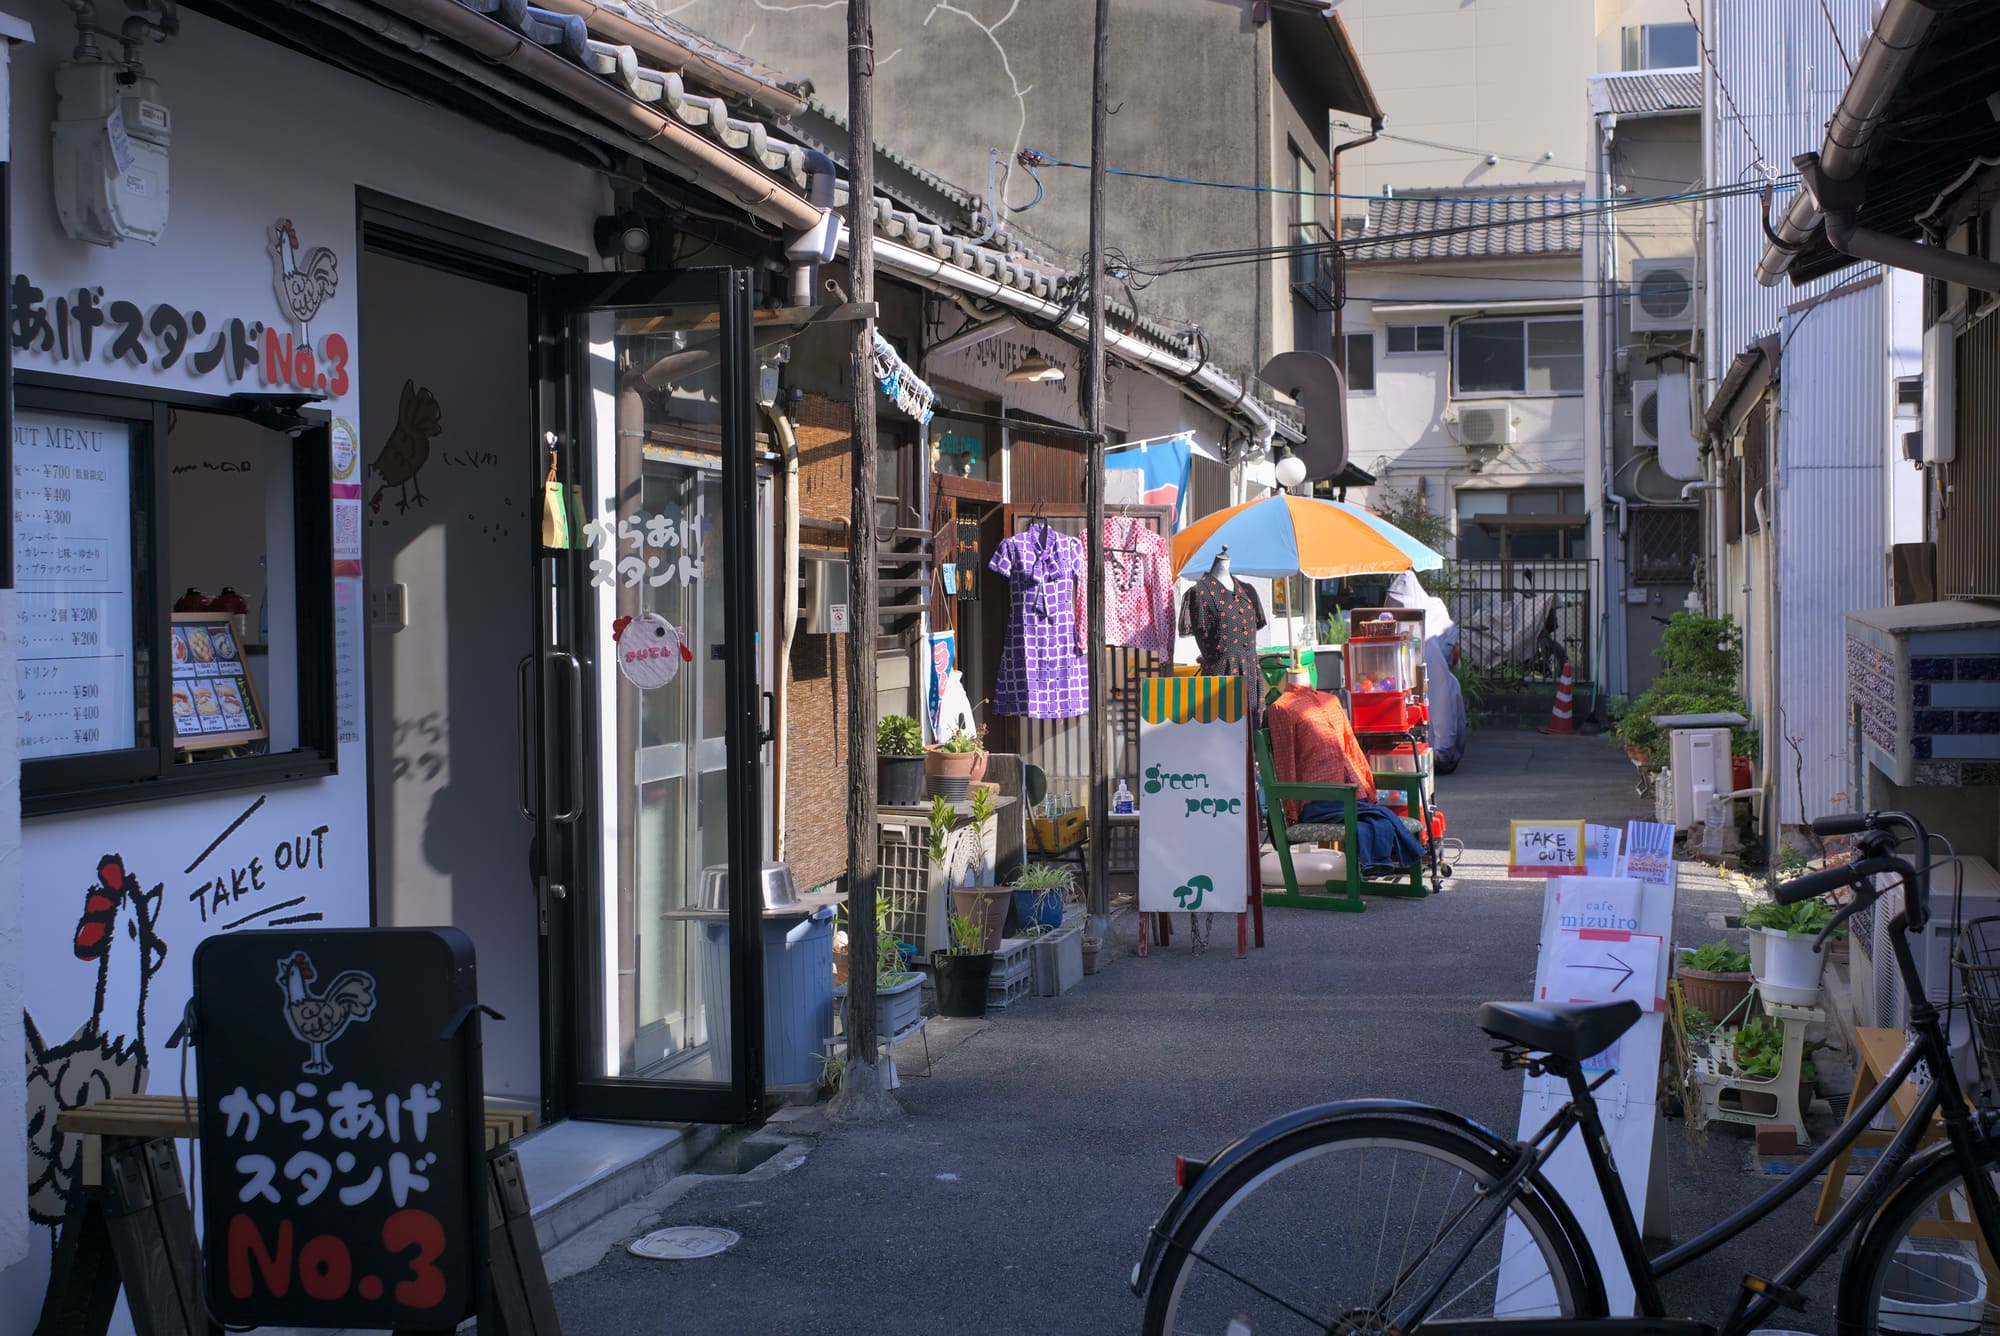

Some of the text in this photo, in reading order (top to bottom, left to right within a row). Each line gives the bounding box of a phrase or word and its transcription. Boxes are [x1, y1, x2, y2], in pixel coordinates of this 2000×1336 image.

[998, 339, 1018, 371] LIFE
[14, 427, 103, 453] UT MENU
[43, 464, 71, 480] ¥700
[44, 488, 71, 502] ¥400
[45, 509, 72, 525] ¥300
[71, 607, 97, 622] ¥200
[72, 632, 98, 646] ¥200
[24, 666, 59, 680] ドリンク
[73, 685, 99, 699] ¥500
[73, 706, 100, 721] ¥400
[74, 728, 100, 743] ¥400
[1144, 763, 1209, 794] green
[1185, 797, 1241, 818] pepe
[1520, 831, 1567, 848] TAKE
[190, 825, 329, 923] TAKE OUT
[1586, 901, 1614, 911] cafe
[1560, 912, 1639, 930] mizuiro
[218, 1081, 441, 1144] からあげ
[235, 1151, 438, 1208] スタンド
[227, 1208, 447, 1309] No.3
